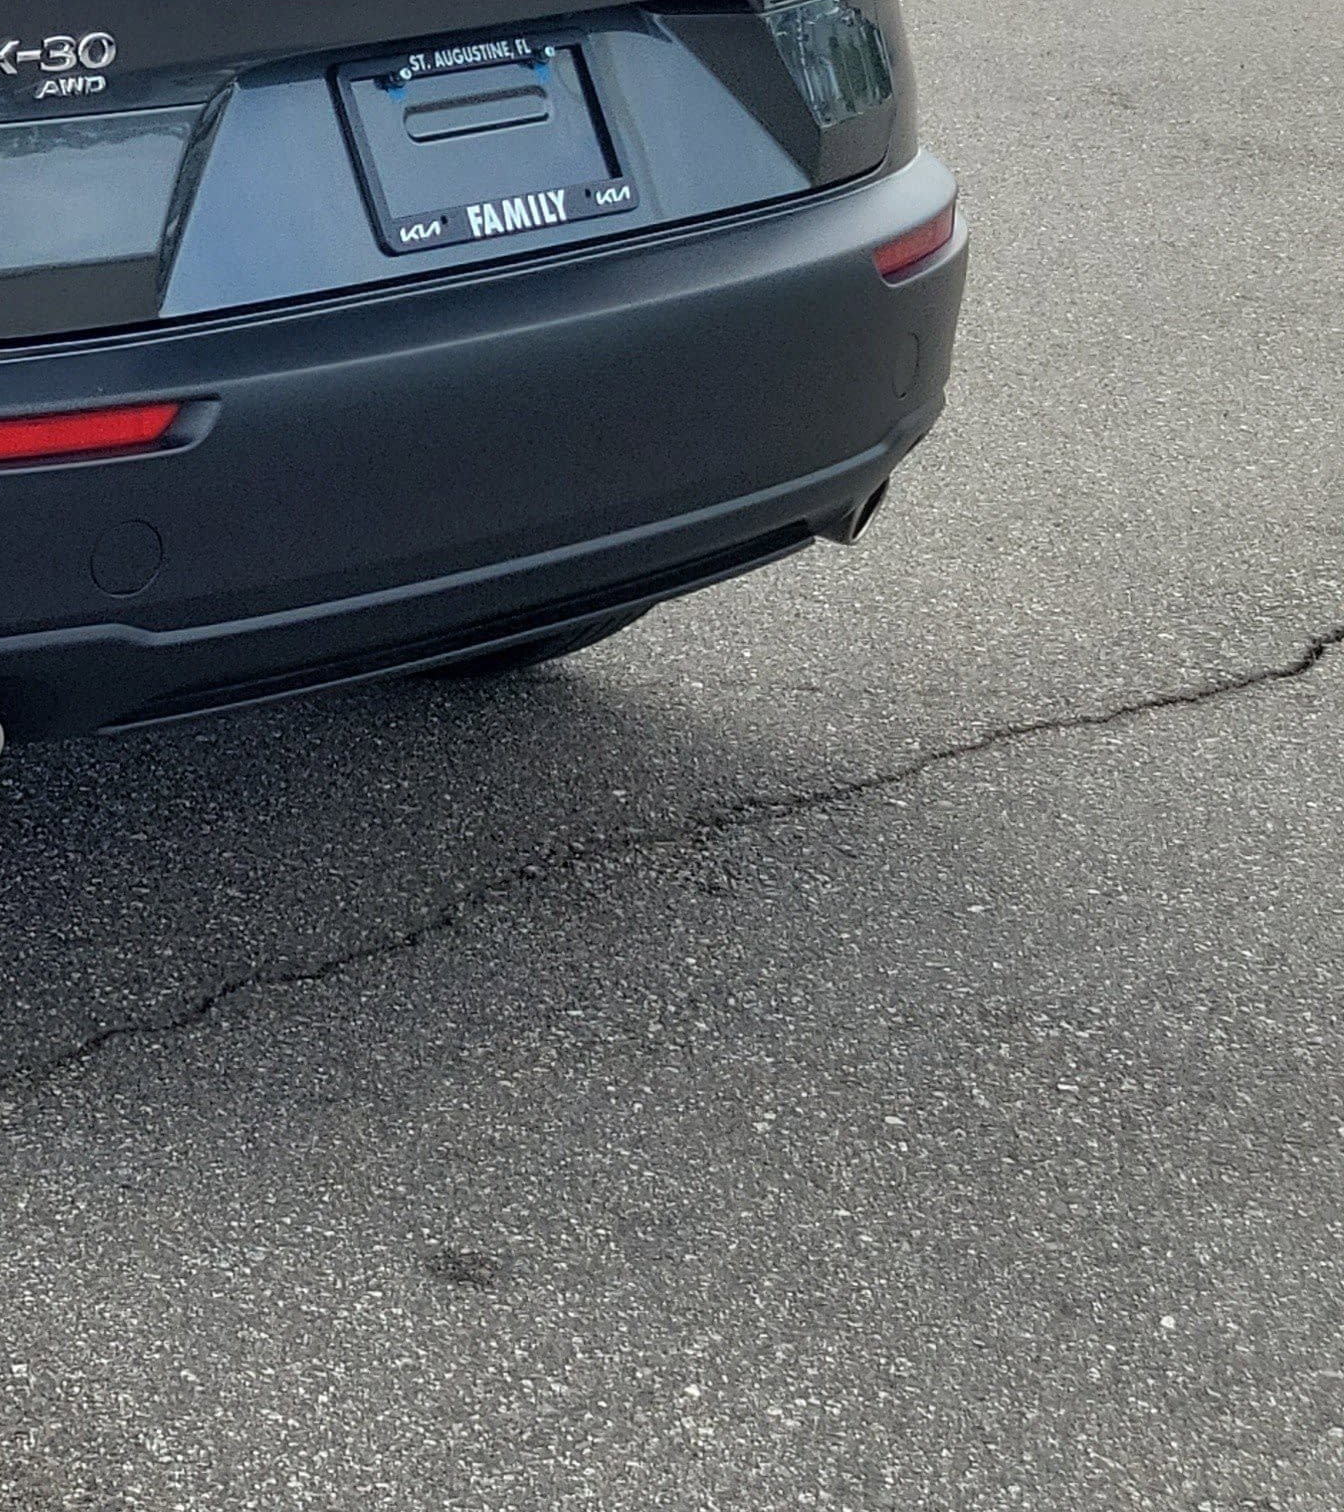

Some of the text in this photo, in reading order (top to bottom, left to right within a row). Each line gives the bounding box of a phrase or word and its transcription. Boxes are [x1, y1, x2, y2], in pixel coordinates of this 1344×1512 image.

[409, 39, 533, 71] ST. AUGUSTINE, FL
[34, 76, 106, 100] AWD
[466, 189, 569, 238] FAMILY
